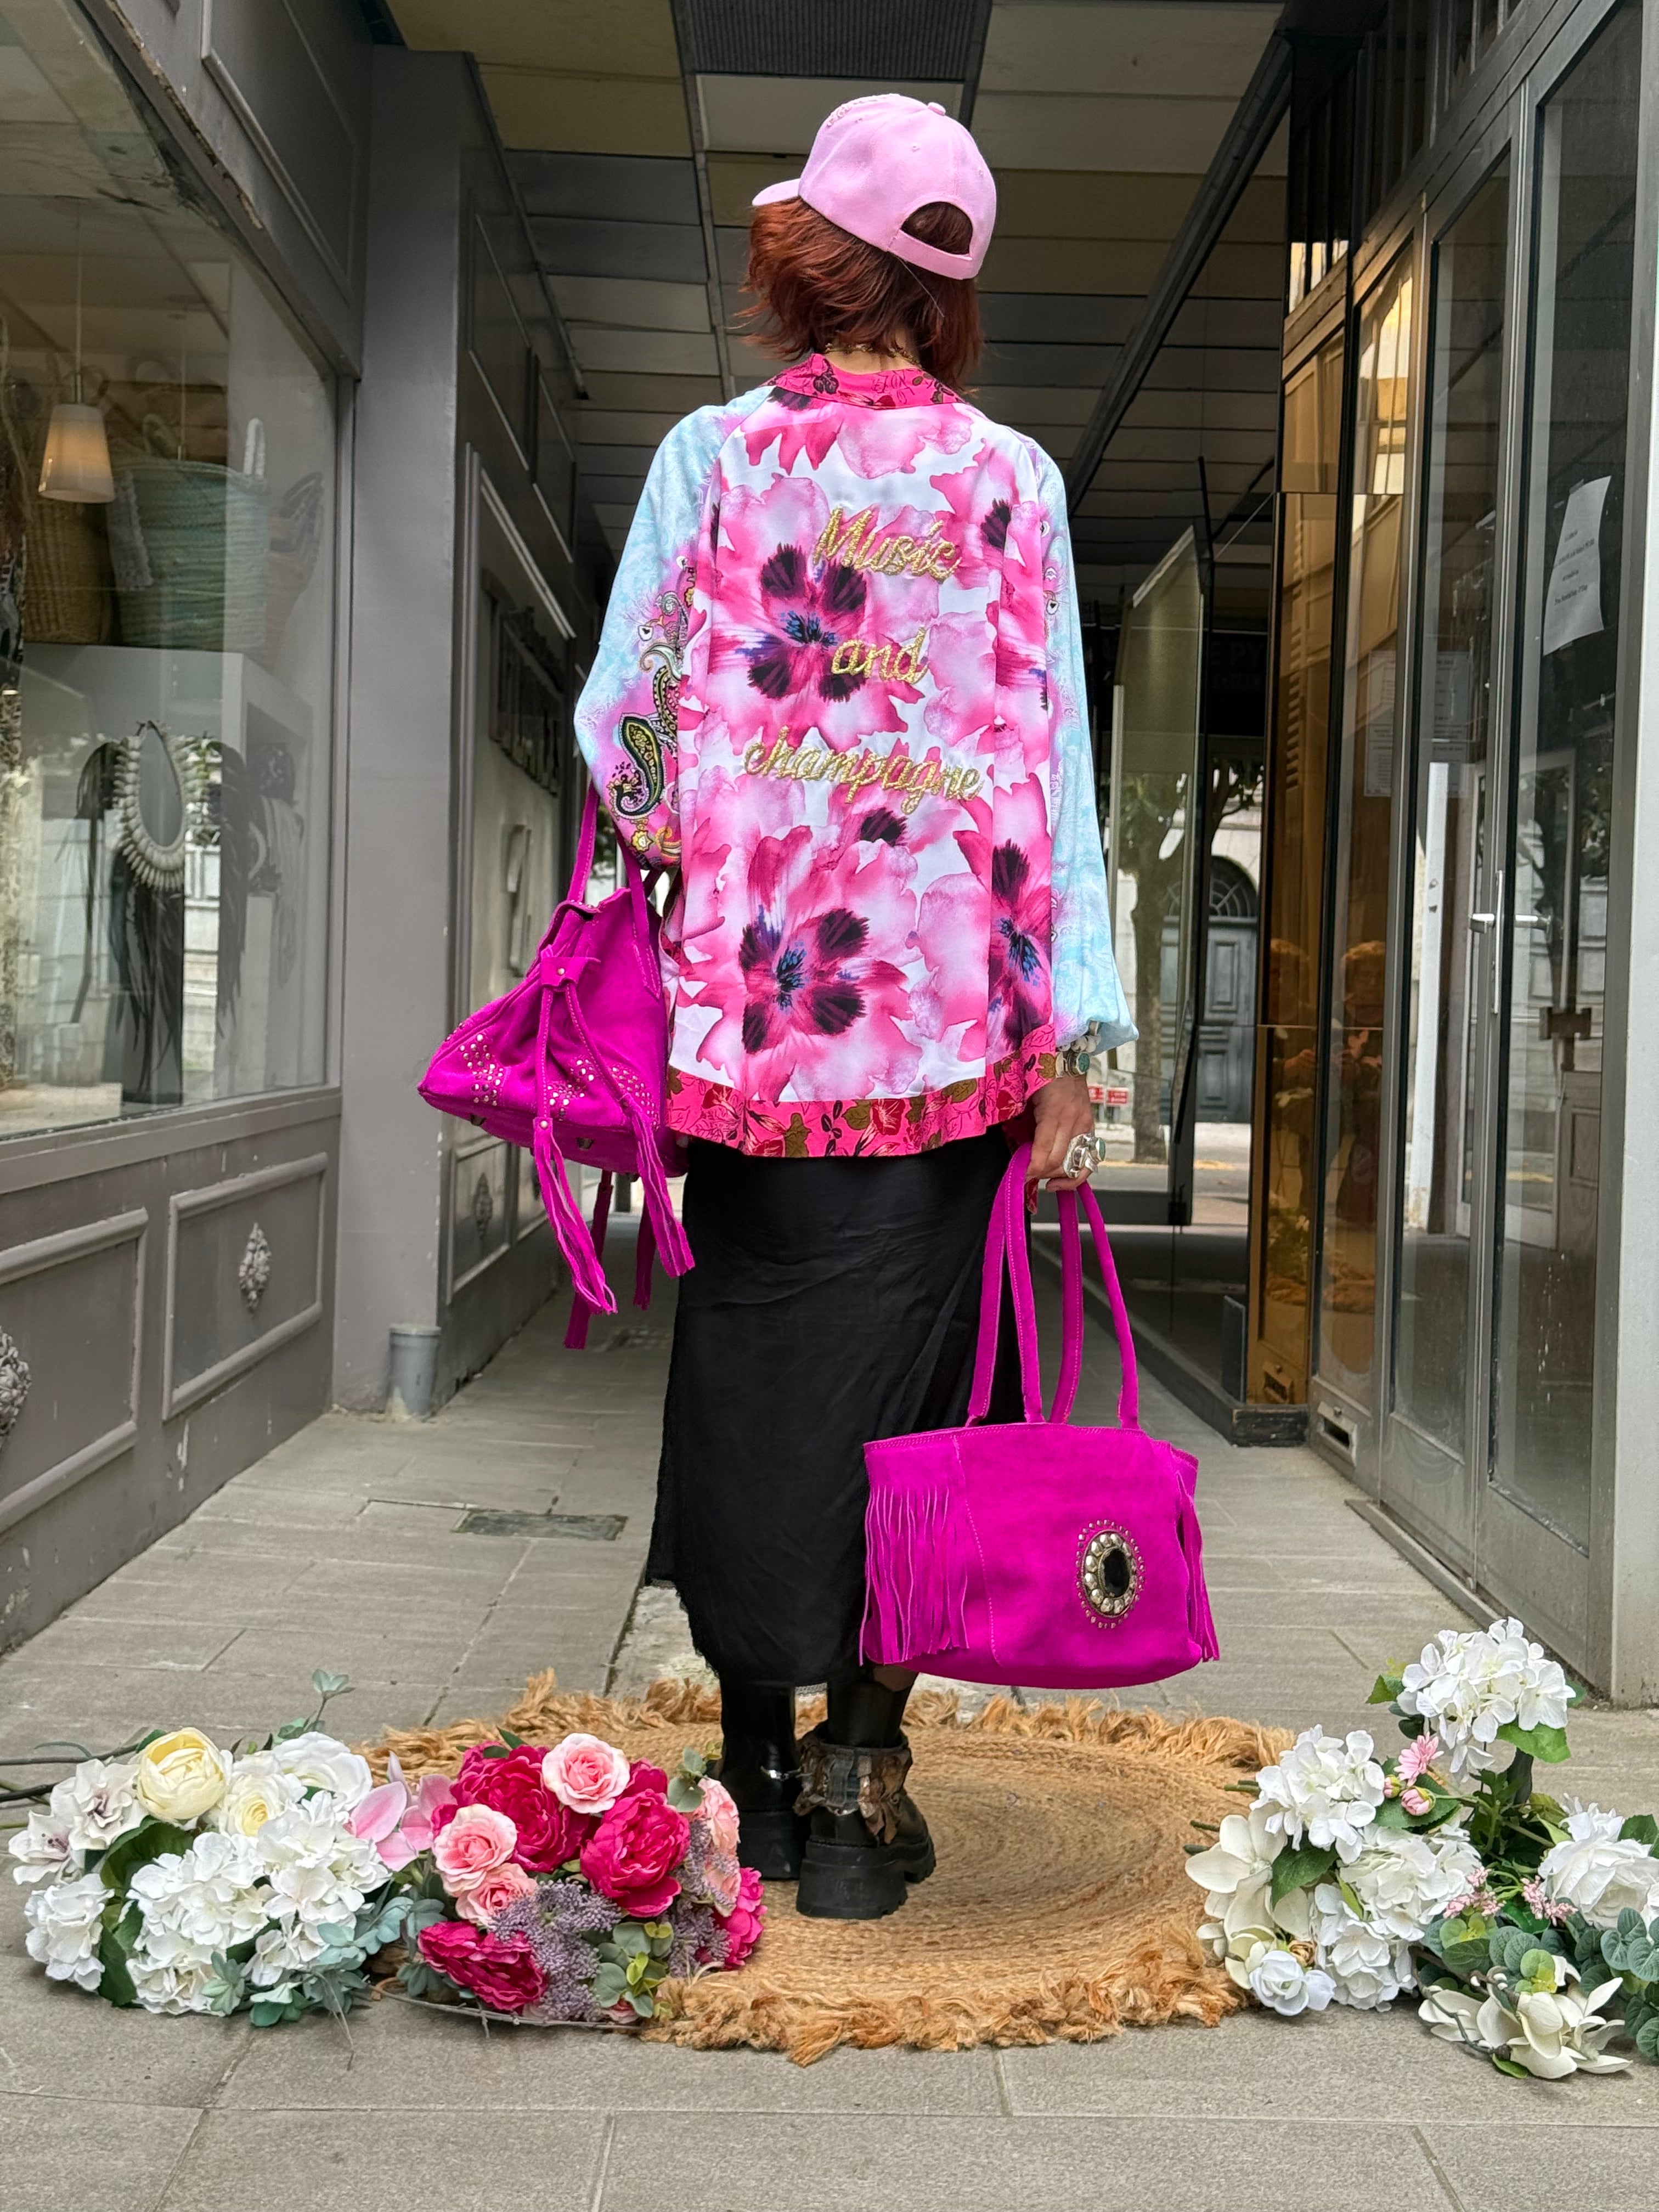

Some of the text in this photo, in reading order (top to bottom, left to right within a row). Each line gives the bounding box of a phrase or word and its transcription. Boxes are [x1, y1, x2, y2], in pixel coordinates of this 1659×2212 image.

[812, 507, 961, 582] Music
[831, 626, 930, 684] and
[744, 725, 984, 815] champagne
